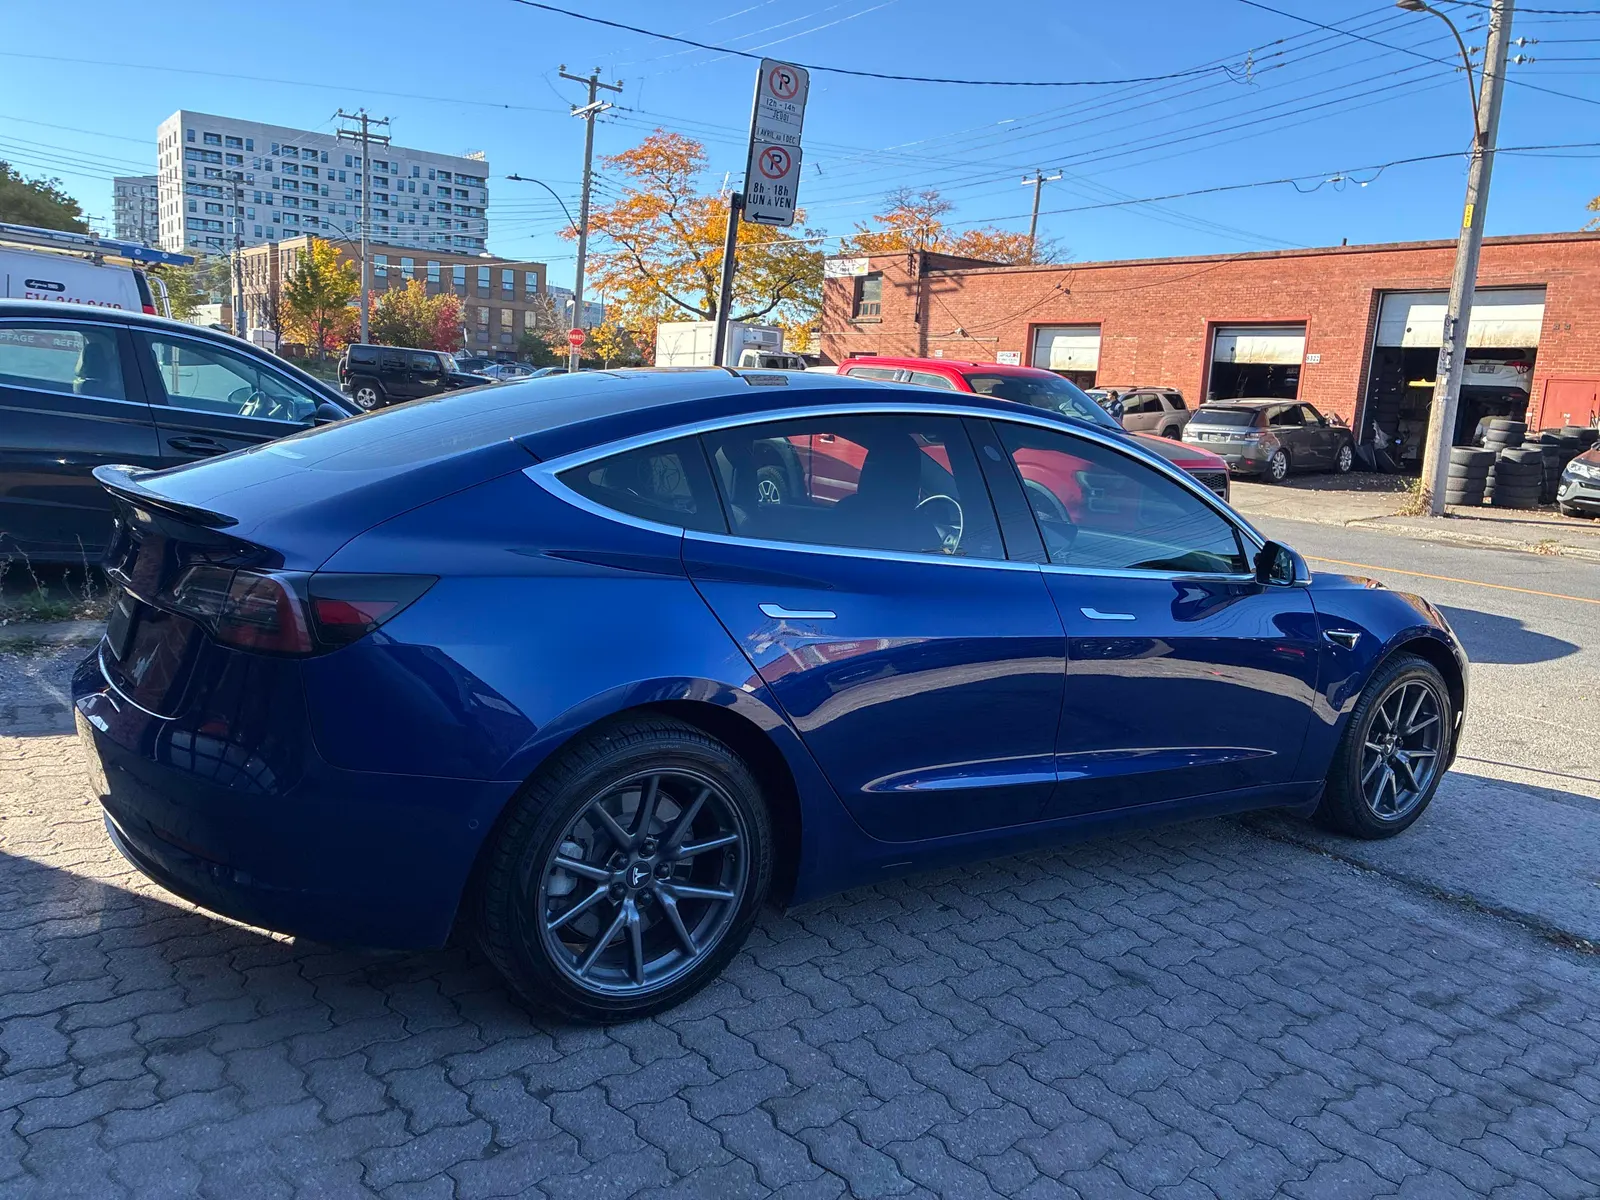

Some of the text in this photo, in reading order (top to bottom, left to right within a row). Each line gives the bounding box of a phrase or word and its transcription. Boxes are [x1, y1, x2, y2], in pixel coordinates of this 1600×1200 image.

[766, 97, 778, 107] 12h
[784, 103, 796, 112] 14h
[772, 109, 790, 122] JEUDI
[760, 128, 775, 139] AVRIL
[753, 182, 765, 193] 8h
[774, 184, 789, 196] 18h
[747, 193, 766, 205] LUN
[774, 196, 792, 208] VEN
